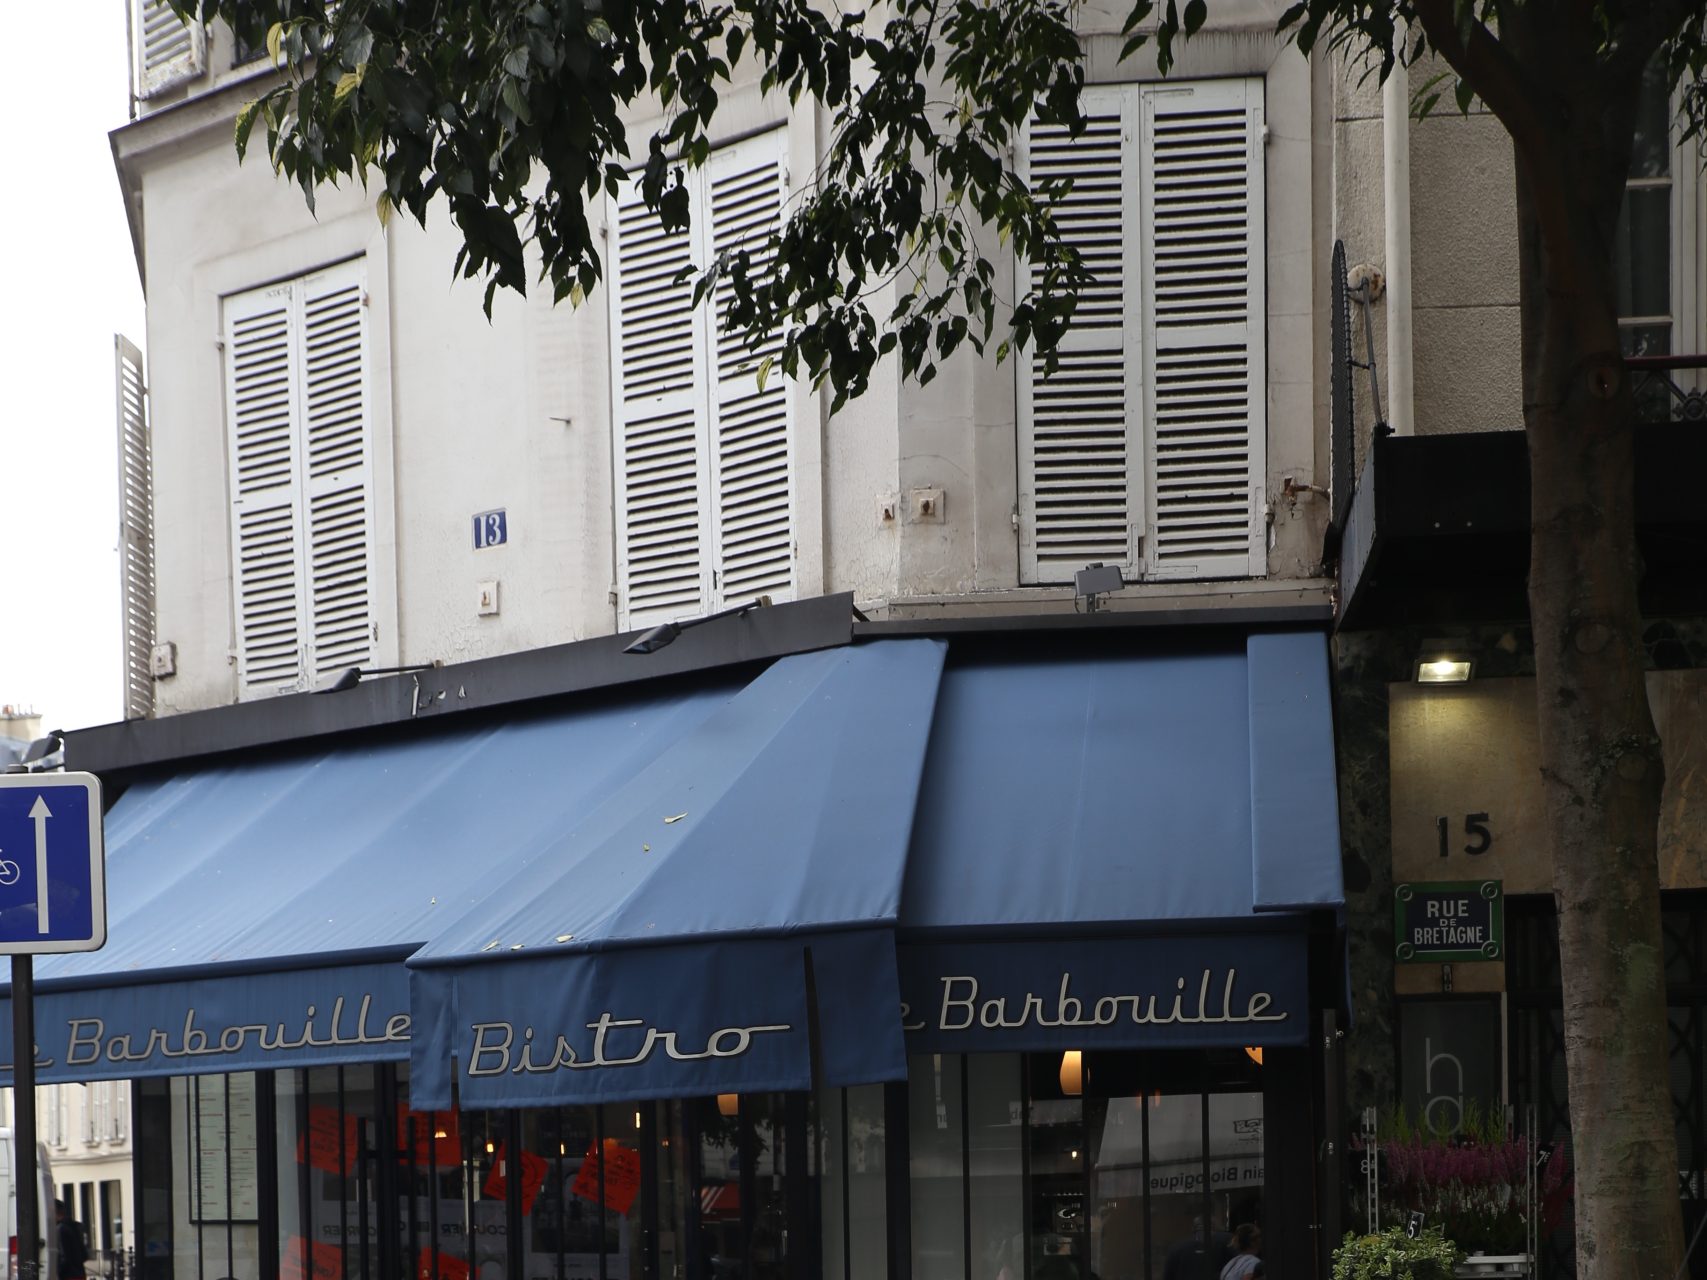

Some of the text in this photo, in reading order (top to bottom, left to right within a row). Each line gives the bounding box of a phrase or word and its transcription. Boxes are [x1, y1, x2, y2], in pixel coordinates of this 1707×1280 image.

[479, 513, 502, 547] 13
[1436, 812, 1492, 858] 15
[1426, 899, 1470, 918] RUE
[1439, 918, 1457, 927] DE
[1413, 926, 1484, 945] BRETAGNE
[938, 968, 1289, 1031] Barbouille
[66, 993, 411, 1066] Barbouille
[468, 1012, 790, 1078] Bistro
